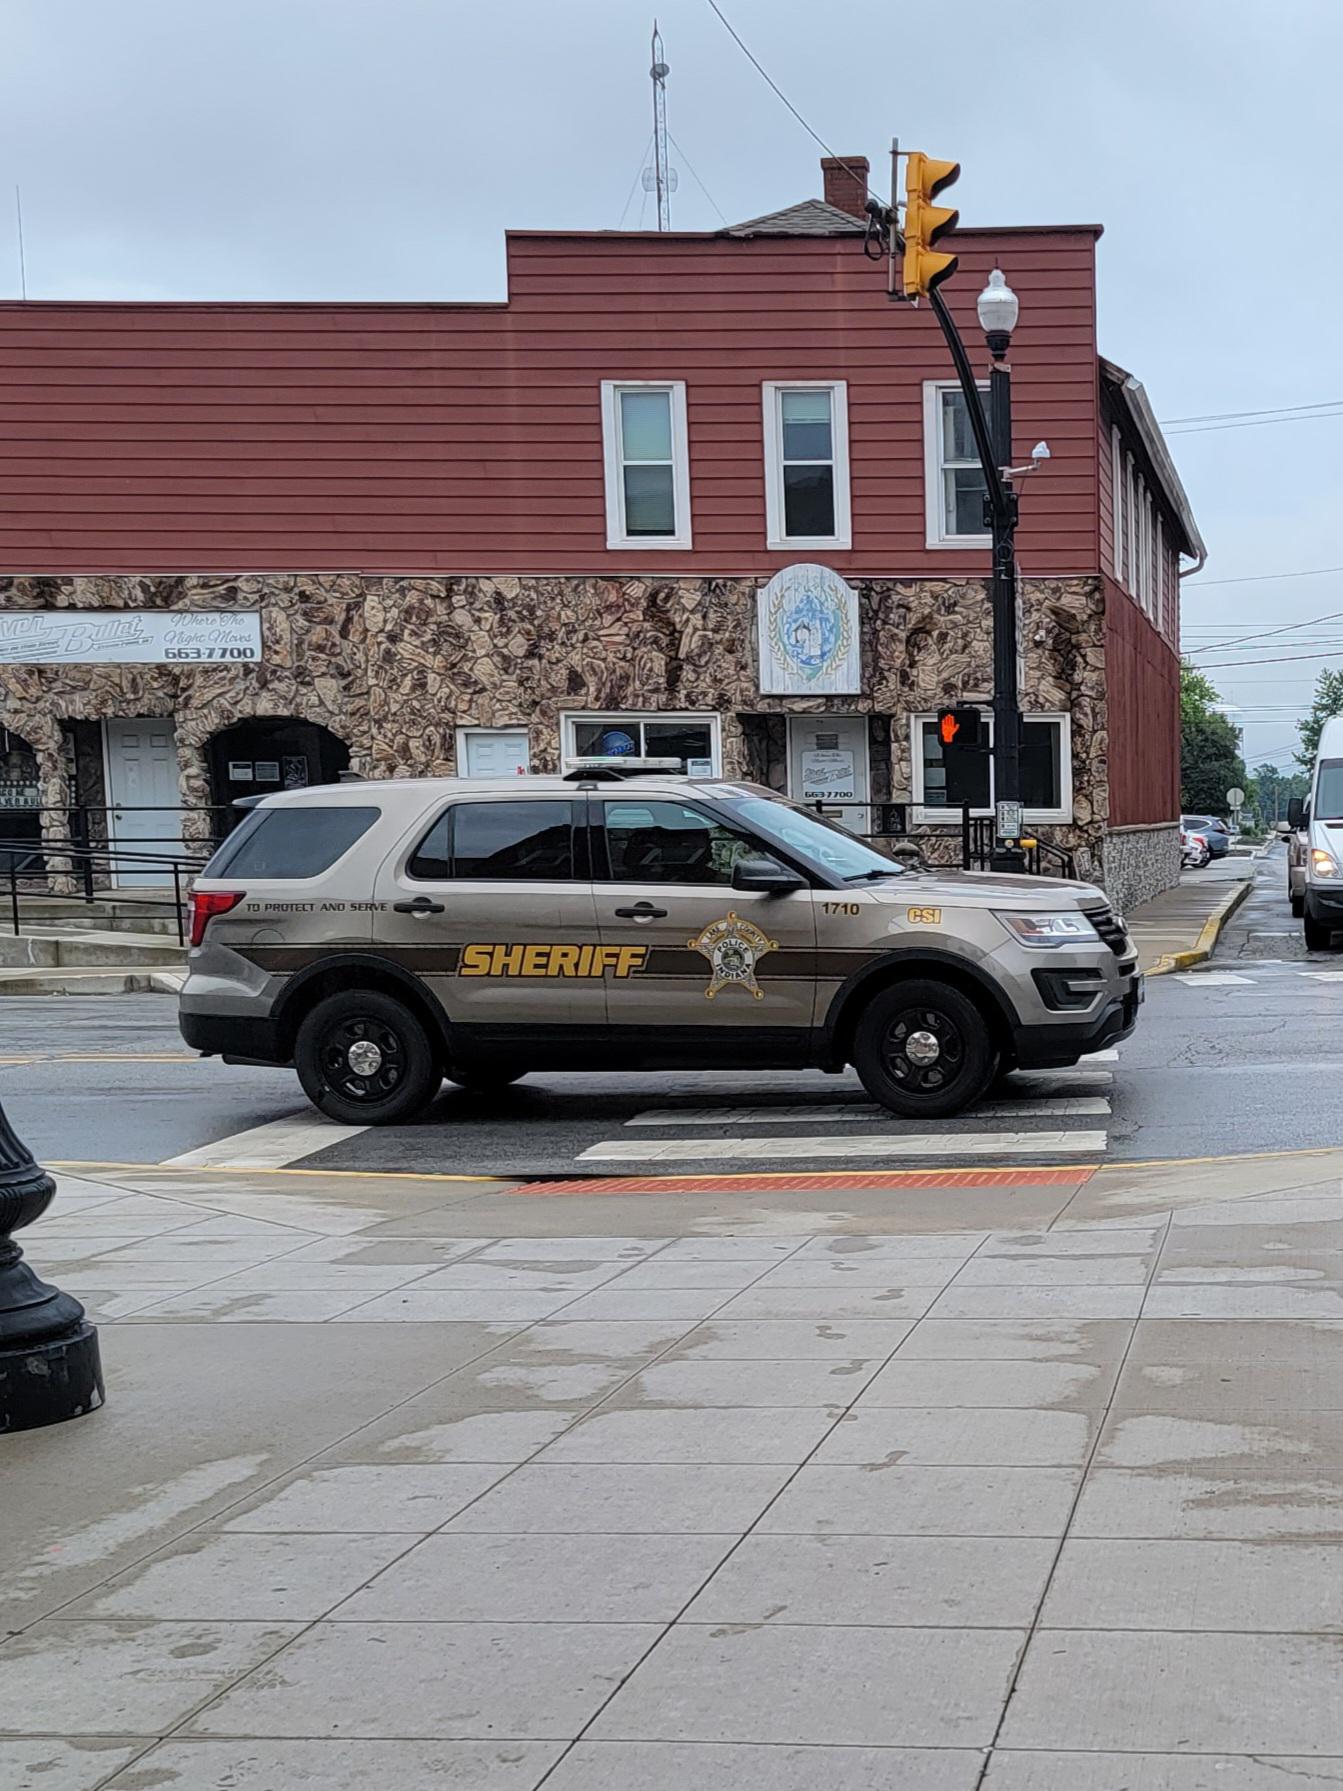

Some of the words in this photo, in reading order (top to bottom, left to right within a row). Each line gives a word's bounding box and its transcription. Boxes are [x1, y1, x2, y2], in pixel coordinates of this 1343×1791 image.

[171, 611, 217, 627] Where
[219, 611, 246, 627] The
[56, 614, 144, 654] Bullet
[164, 629, 206, 646] Night
[208, 628, 254, 643] Moves
[164, 647, 255, 659] 663-7700
[246, 903, 260, 912] TO
[264, 903, 315, 912] PROTECT
[320, 903, 345, 912] AND
[350, 902, 388, 912] SERVE
[822, 902, 860, 915] 1710
[907, 907, 942, 924] CSI
[717, 939, 750, 953] POLICE
[459, 944, 648, 978] SHERIFF
[716, 963, 752, 979] INDIANA
